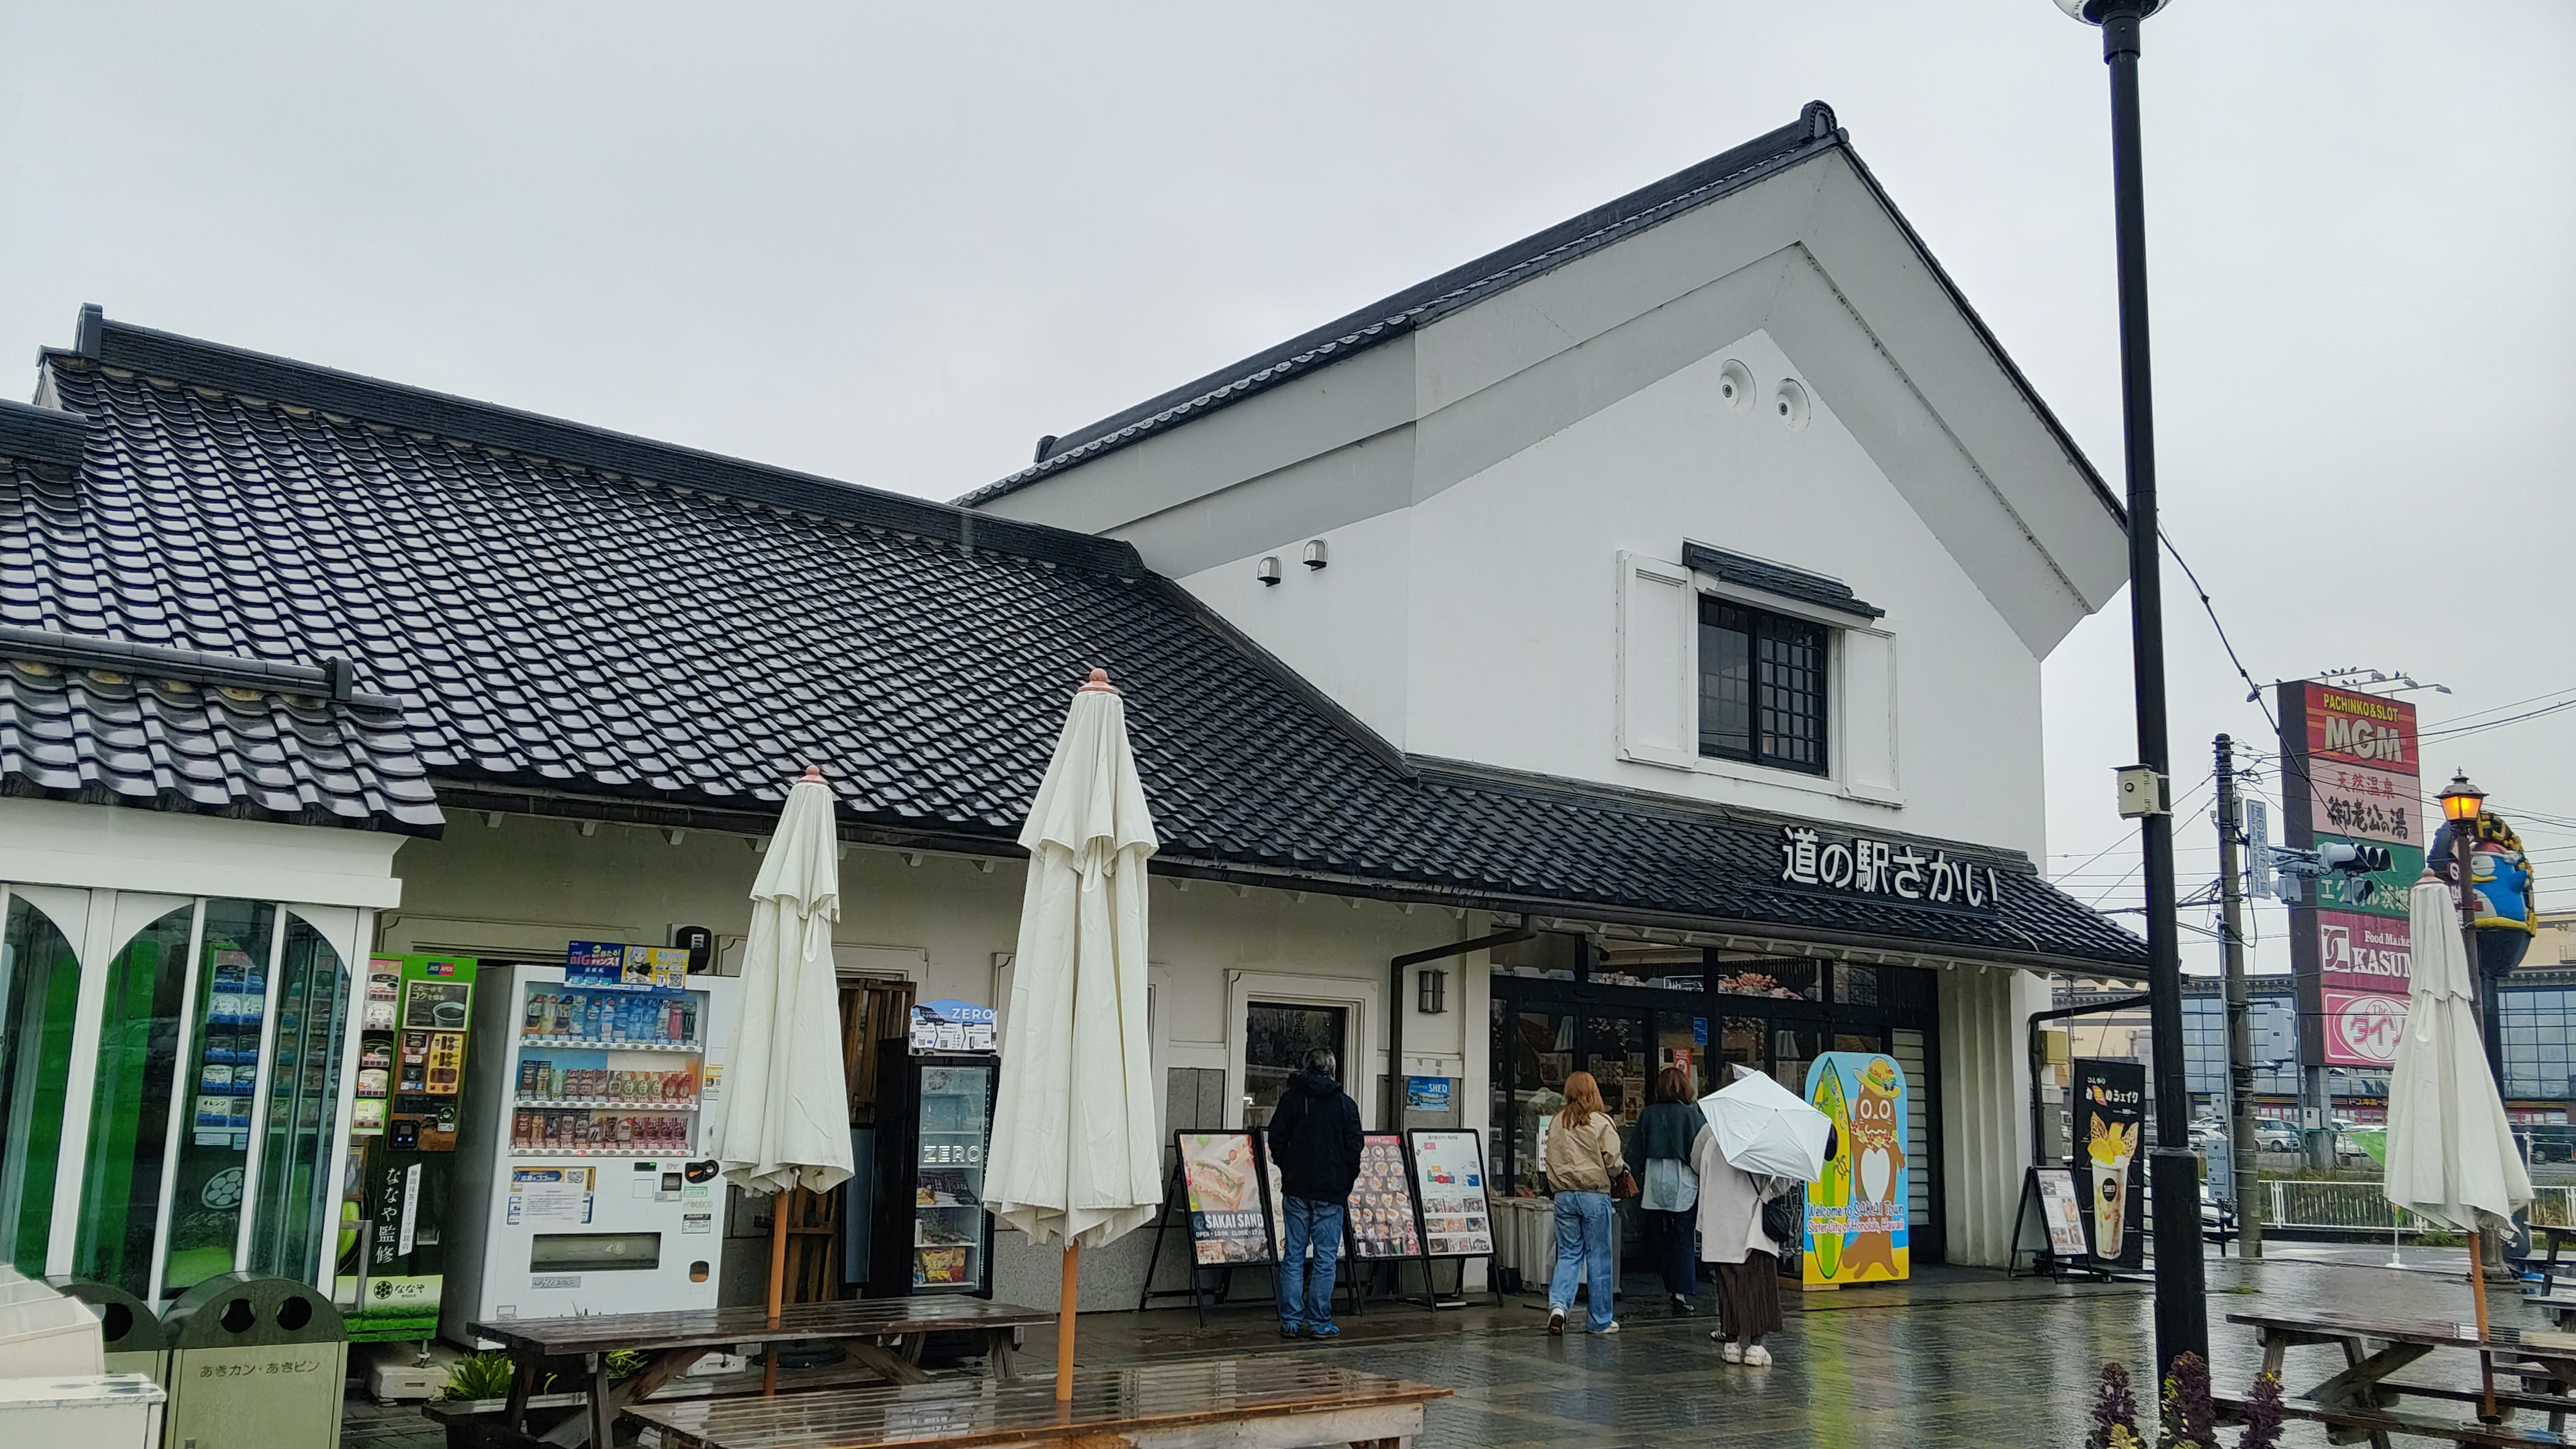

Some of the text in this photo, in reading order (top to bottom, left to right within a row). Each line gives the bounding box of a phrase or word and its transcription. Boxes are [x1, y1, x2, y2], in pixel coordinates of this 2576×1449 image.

[2323, 693, 2399, 722] PACHINKO&SLOT
[2324, 716, 2402, 763] MGM
[2336, 771, 2395, 799] 天然温泉
[2327, 795, 2408, 840] 御老公の湯
[1782, 826, 1998, 907] 道の駅さかい
[2364, 930, 2384, 944] Food
[952, 1008, 993, 1020] ZERO
[2372, 1004, 2388, 1014] The
[1428, 1083, 1448, 1094] SHED
[923, 1145, 981, 1163] ZERO
[375, 1167, 401, 1264] ななや監修
[1807, 1201, 1904, 1218] Welcome to SAKAI Town
[1205, 1213, 1264, 1229] SAKAI SAND
[1807, 1221, 1828, 1233] Sister
[1828, 1219, 1843, 1236] City
[1843, 1219, 1850, 1231] of
[1880, 1218, 1904, 1231] Hawaii
[394, 1284, 425, 1294] ななや
[200, 1360, 320, 1378] あきカン・あきビン
